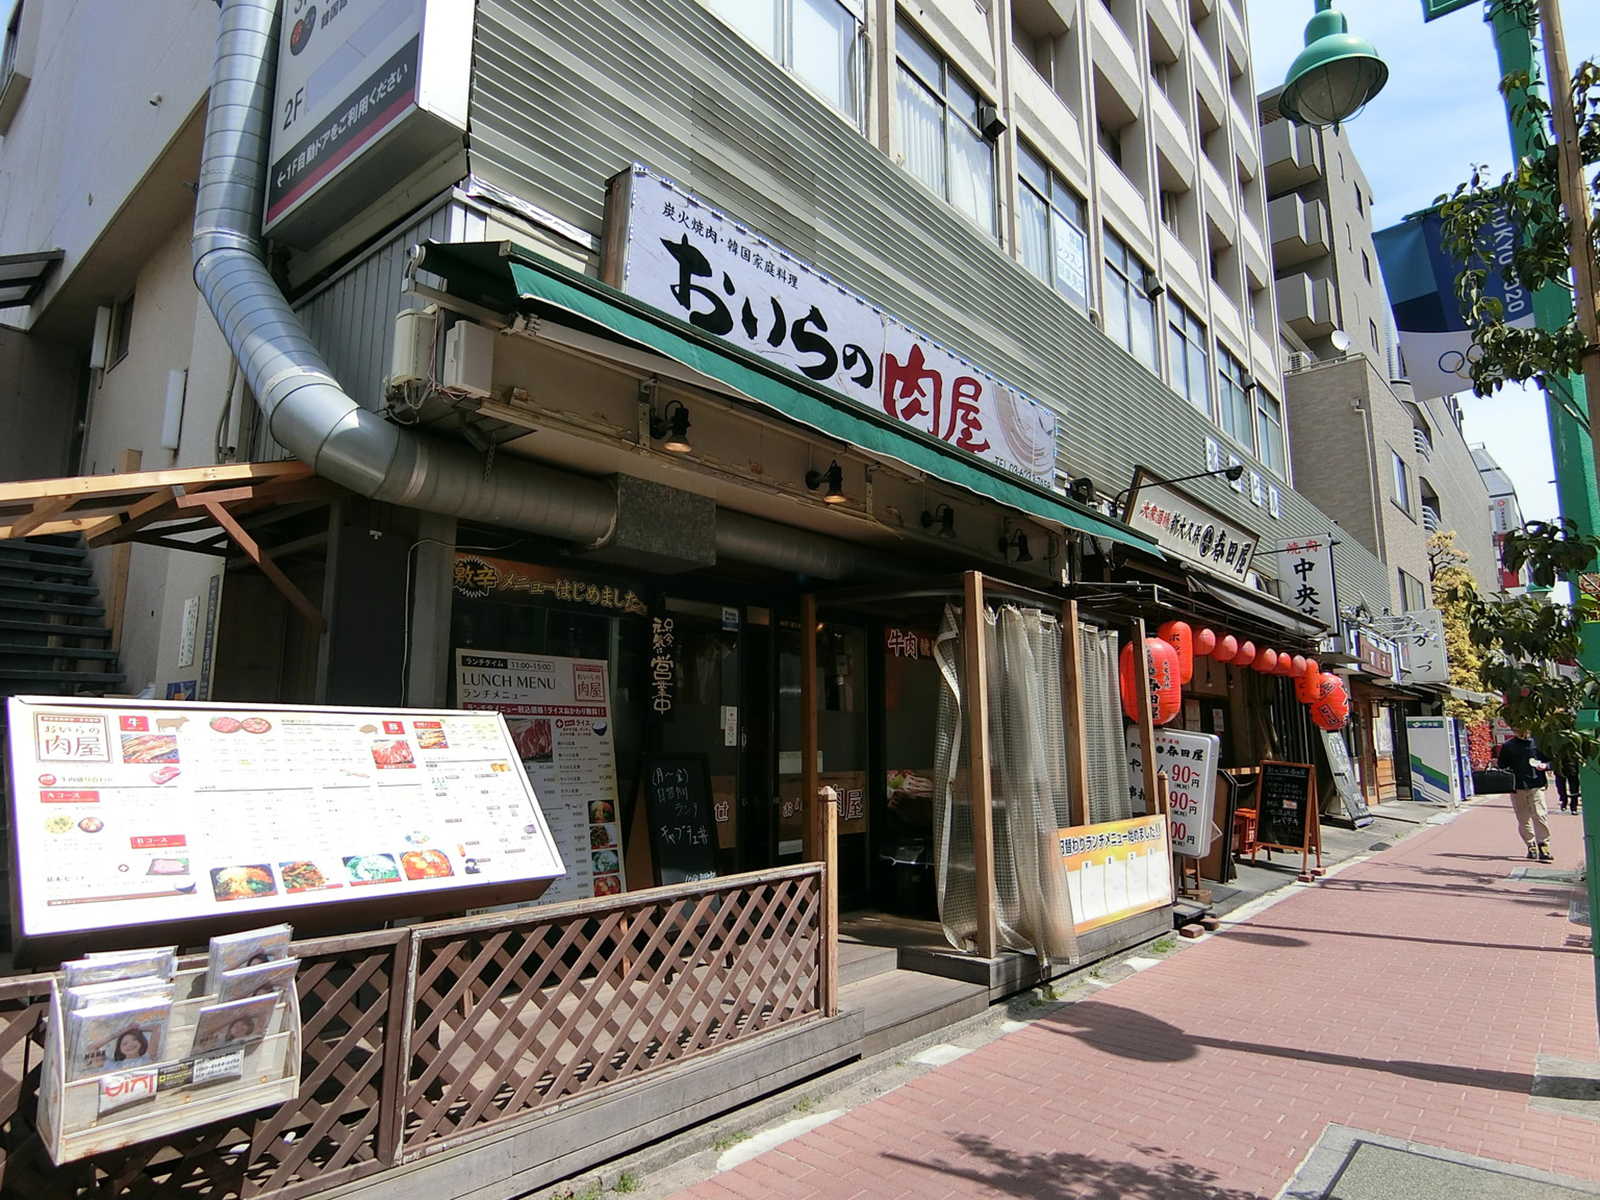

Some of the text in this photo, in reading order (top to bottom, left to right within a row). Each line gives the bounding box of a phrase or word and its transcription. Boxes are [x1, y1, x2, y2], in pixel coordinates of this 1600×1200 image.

[283, 86, 304, 131] 2F
[285, 63, 409, 179] 1F自動ドアをご利用ください
[662, 202, 800, 291] 炭火焼肉・韓国家庭料理
[659, 232, 990, 455] おいらの肉屋
[1211, 530, 1252, 574] 春田屋
[887, 629, 918, 660] 牛肉
[465, 658, 504, 668] ランチタイム
[462, 672, 556, 690] LUNCH MENU
[577, 674, 601, 682] おいらの
[651, 653, 674, 715] 営業中
[463, 688, 528, 699] ランチメニュー
[577, 681, 603, 698] 肉屋
[44, 725, 101, 735] おいらの
[128, 717, 141, 727] 牛
[575, 719, 590, 727] ライス
[44, 735, 105, 757] 肉屋
[1166, 745, 1204, 761] 春田屋
[1191, 779, 1200, 788] 円
[1188, 806, 1197, 815] 円
[1186, 835, 1195, 845] 円
